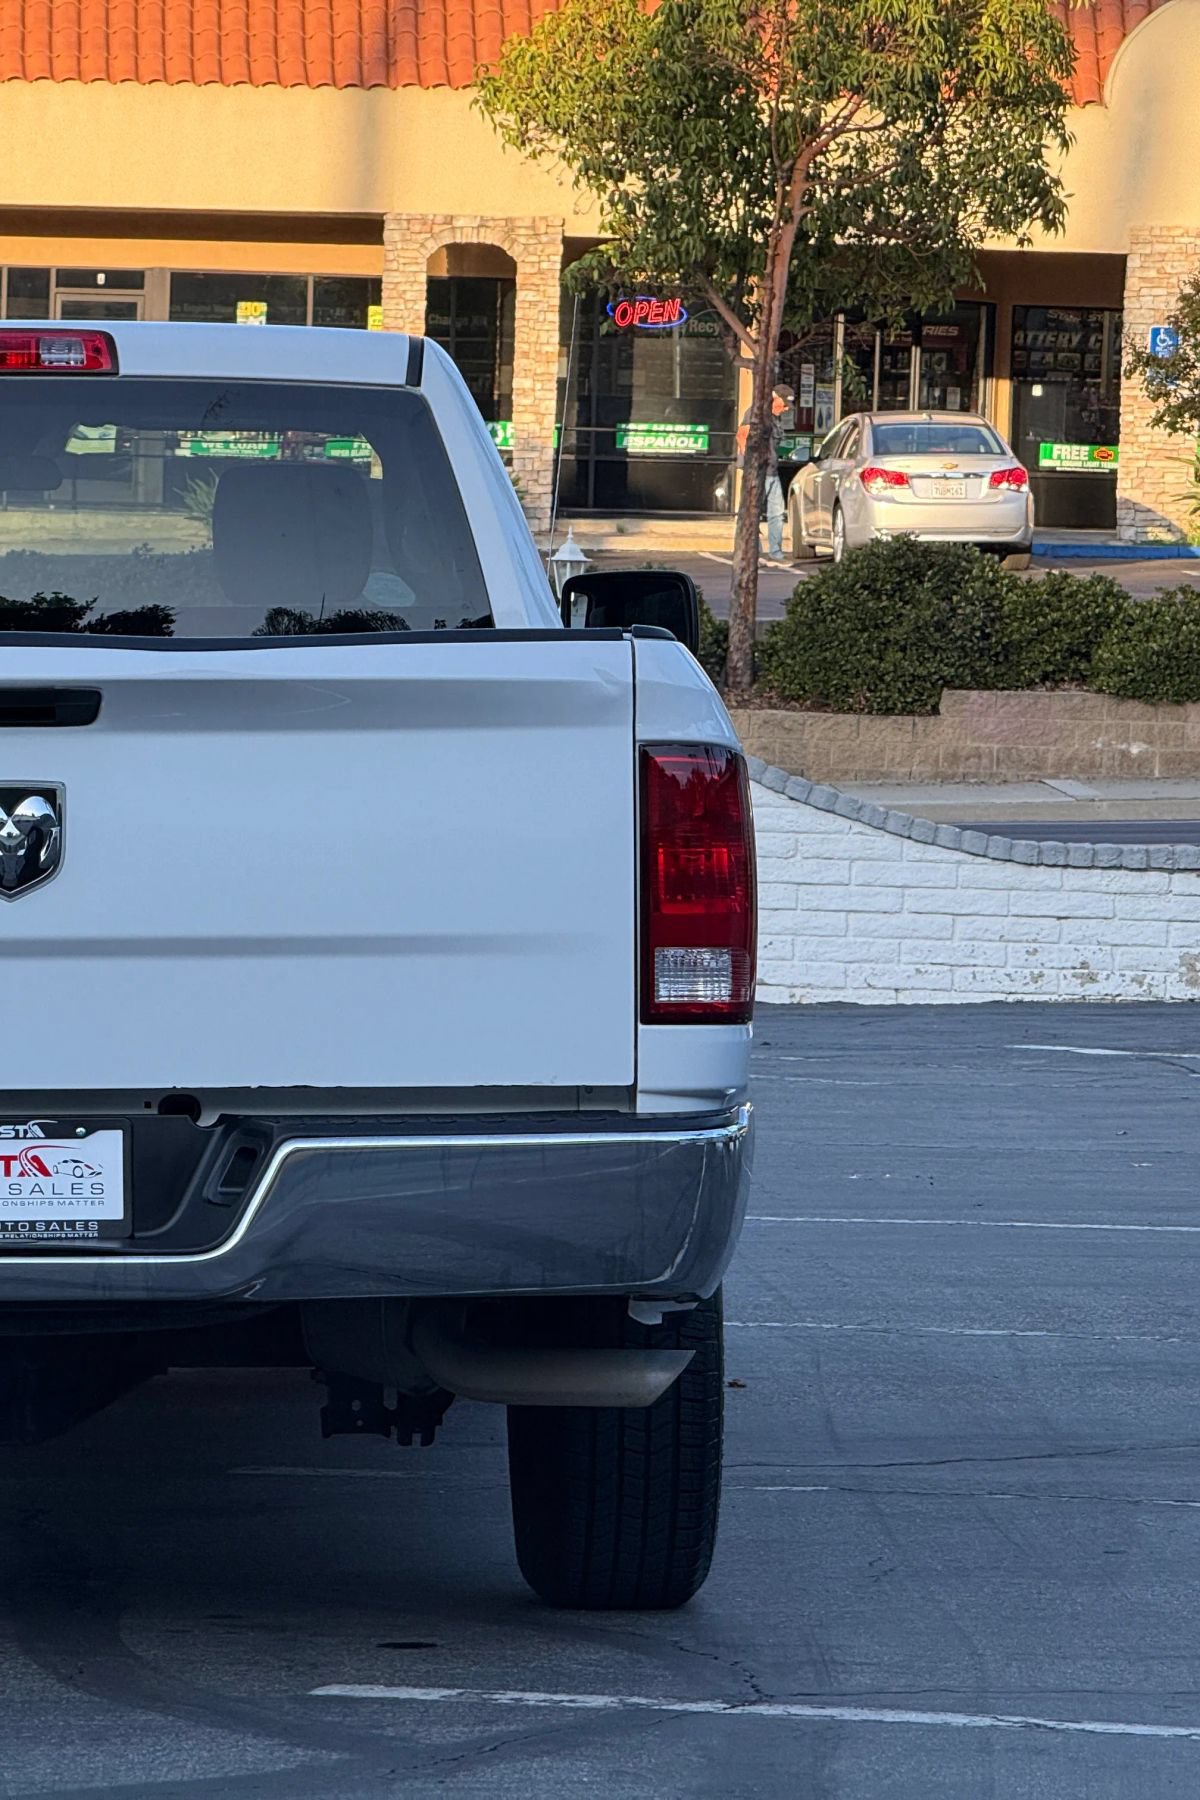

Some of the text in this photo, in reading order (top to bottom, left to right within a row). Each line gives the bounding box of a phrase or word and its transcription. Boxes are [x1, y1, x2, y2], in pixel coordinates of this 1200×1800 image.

[614, 298, 681, 327] OPEN
[688, 319, 720, 336] Recy
[922, 325, 959, 336] RIES
[1014, 330, 1083, 349] ATTERY
[1053, 443, 1089, 460] FREE
[8, 1182, 105, 1196] SALES
[36, 1221, 99, 1231] SALES
